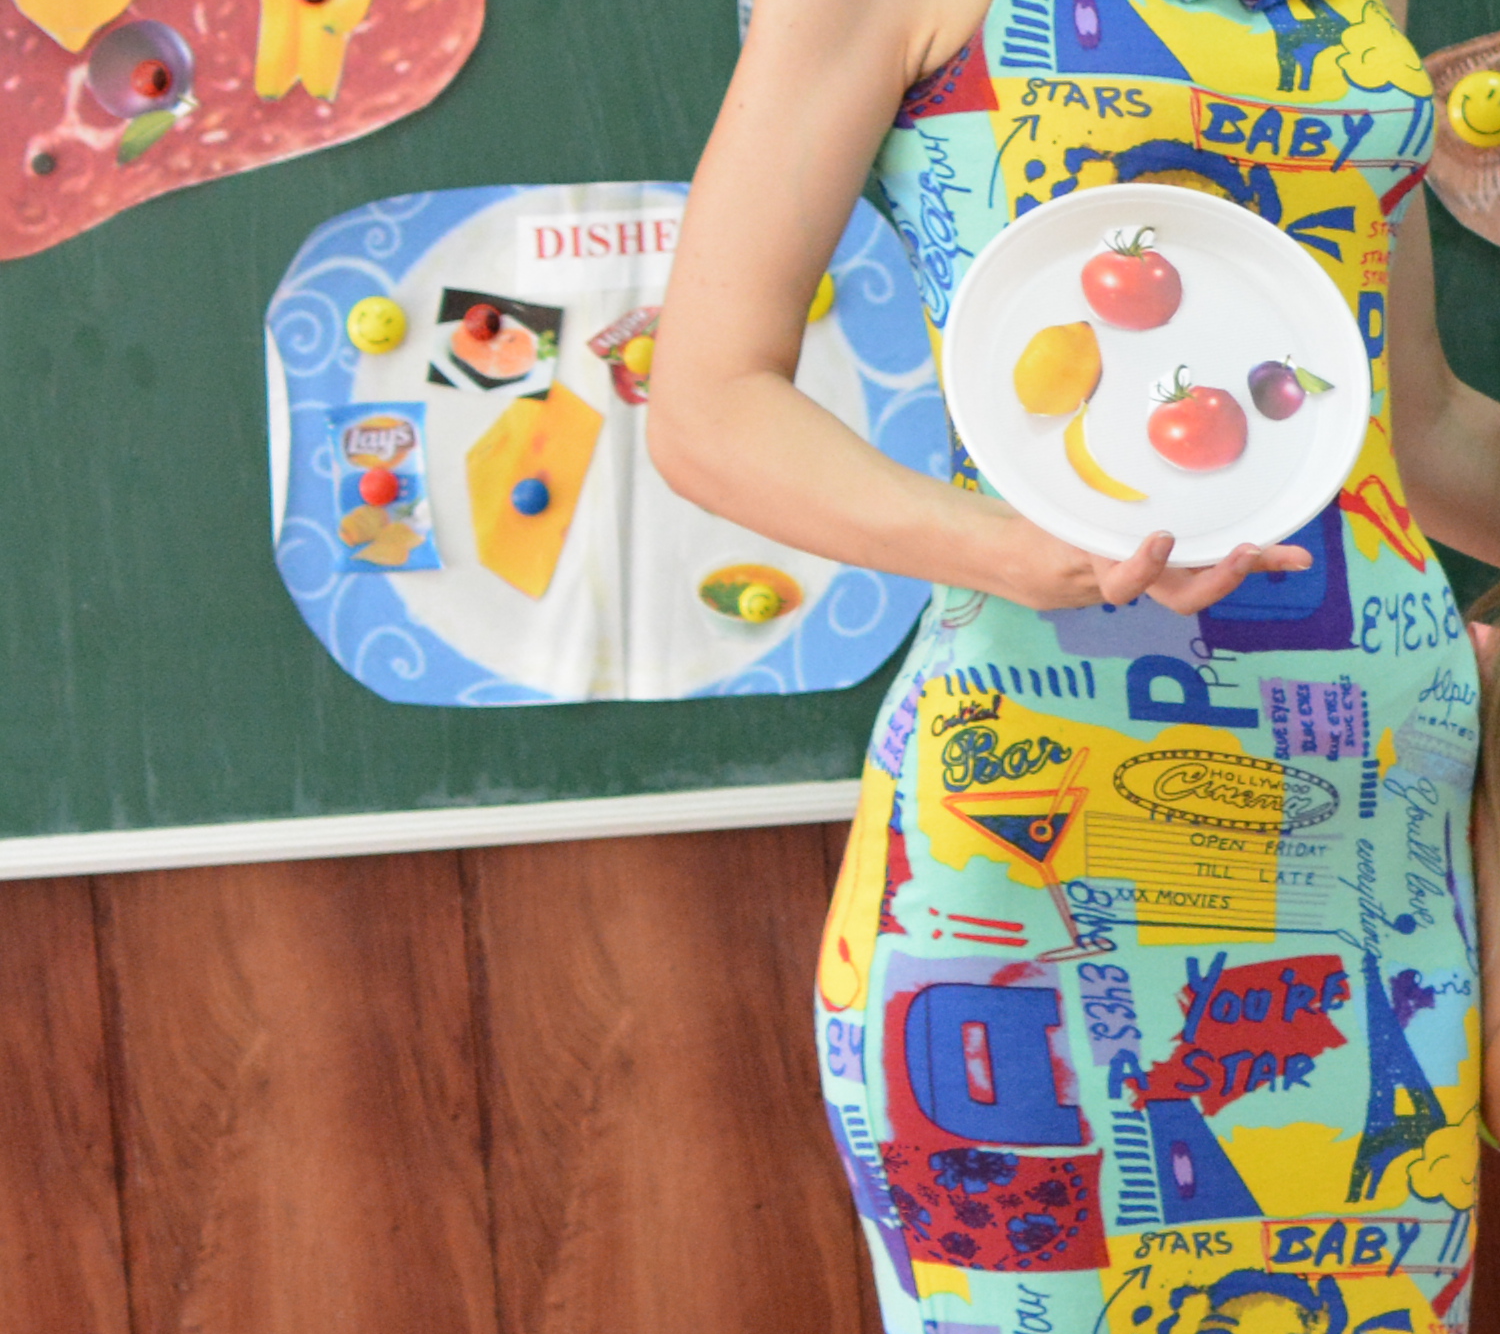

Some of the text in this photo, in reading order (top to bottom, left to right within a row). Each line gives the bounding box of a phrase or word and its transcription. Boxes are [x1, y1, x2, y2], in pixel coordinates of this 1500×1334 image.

[1021, 78, 1153, 118] STARS
[1201, 101, 1374, 172] BABY
[1210, 768, 1312, 795] HOLLYWOOD
[1189, 831, 1328, 858] OPEN FRIDAY
[1194, 862, 1317, 886] TILL LATE
[1155, 888, 1232, 910] MOVIES
[1174, 1048, 1317, 1097] STAR
[1134, 1230, 1234, 1259] STARS
[1272, 1220, 1421, 1278] BABY
